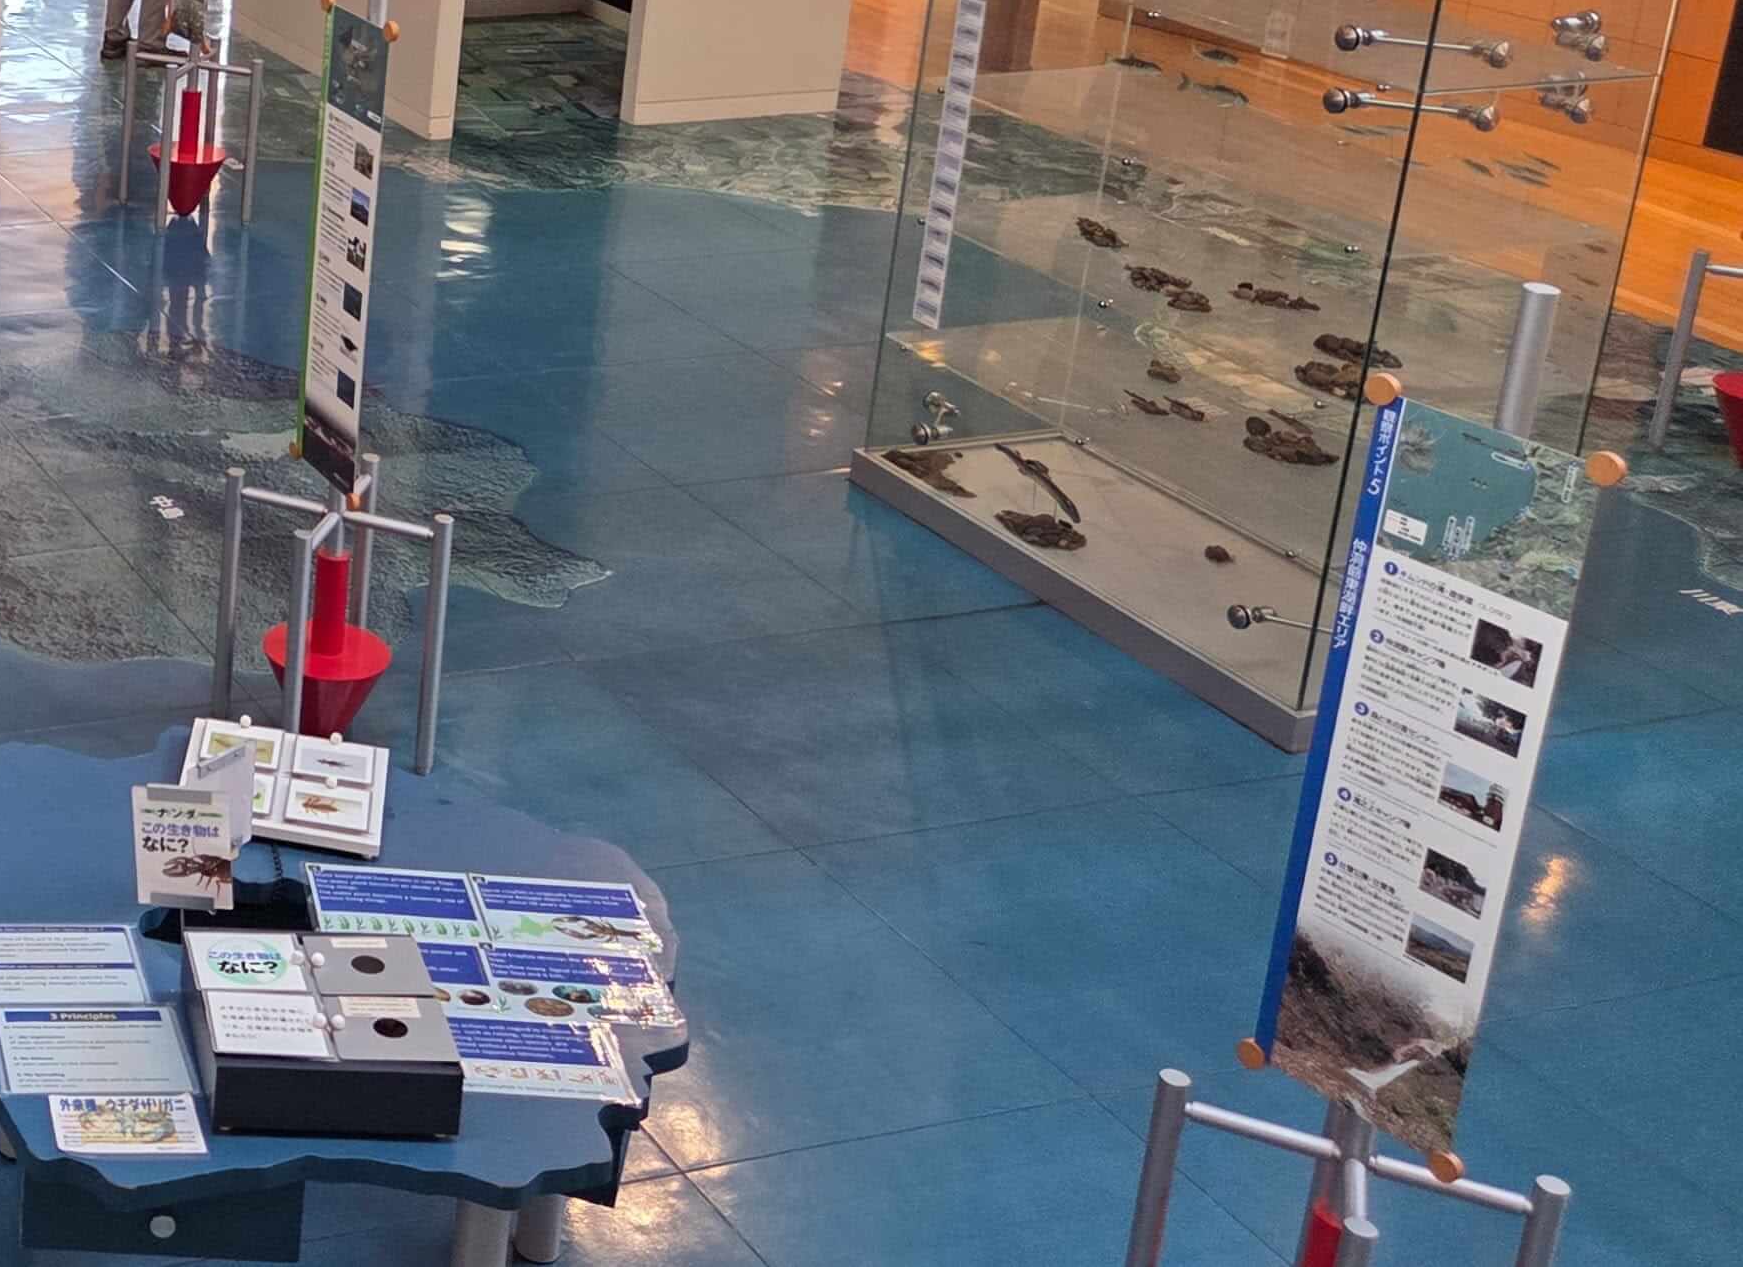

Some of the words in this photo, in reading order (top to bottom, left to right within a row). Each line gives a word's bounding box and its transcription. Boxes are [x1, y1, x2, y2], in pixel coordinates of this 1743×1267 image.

[141, 822, 219, 837] この生き物は
[142, 836, 189, 853] なに?
[208, 949, 282, 961] この生き物は
[218, 960, 279, 975] なに?
[50, 1013, 58, 1021] 3
[60, 1012, 118, 1022] Principles
